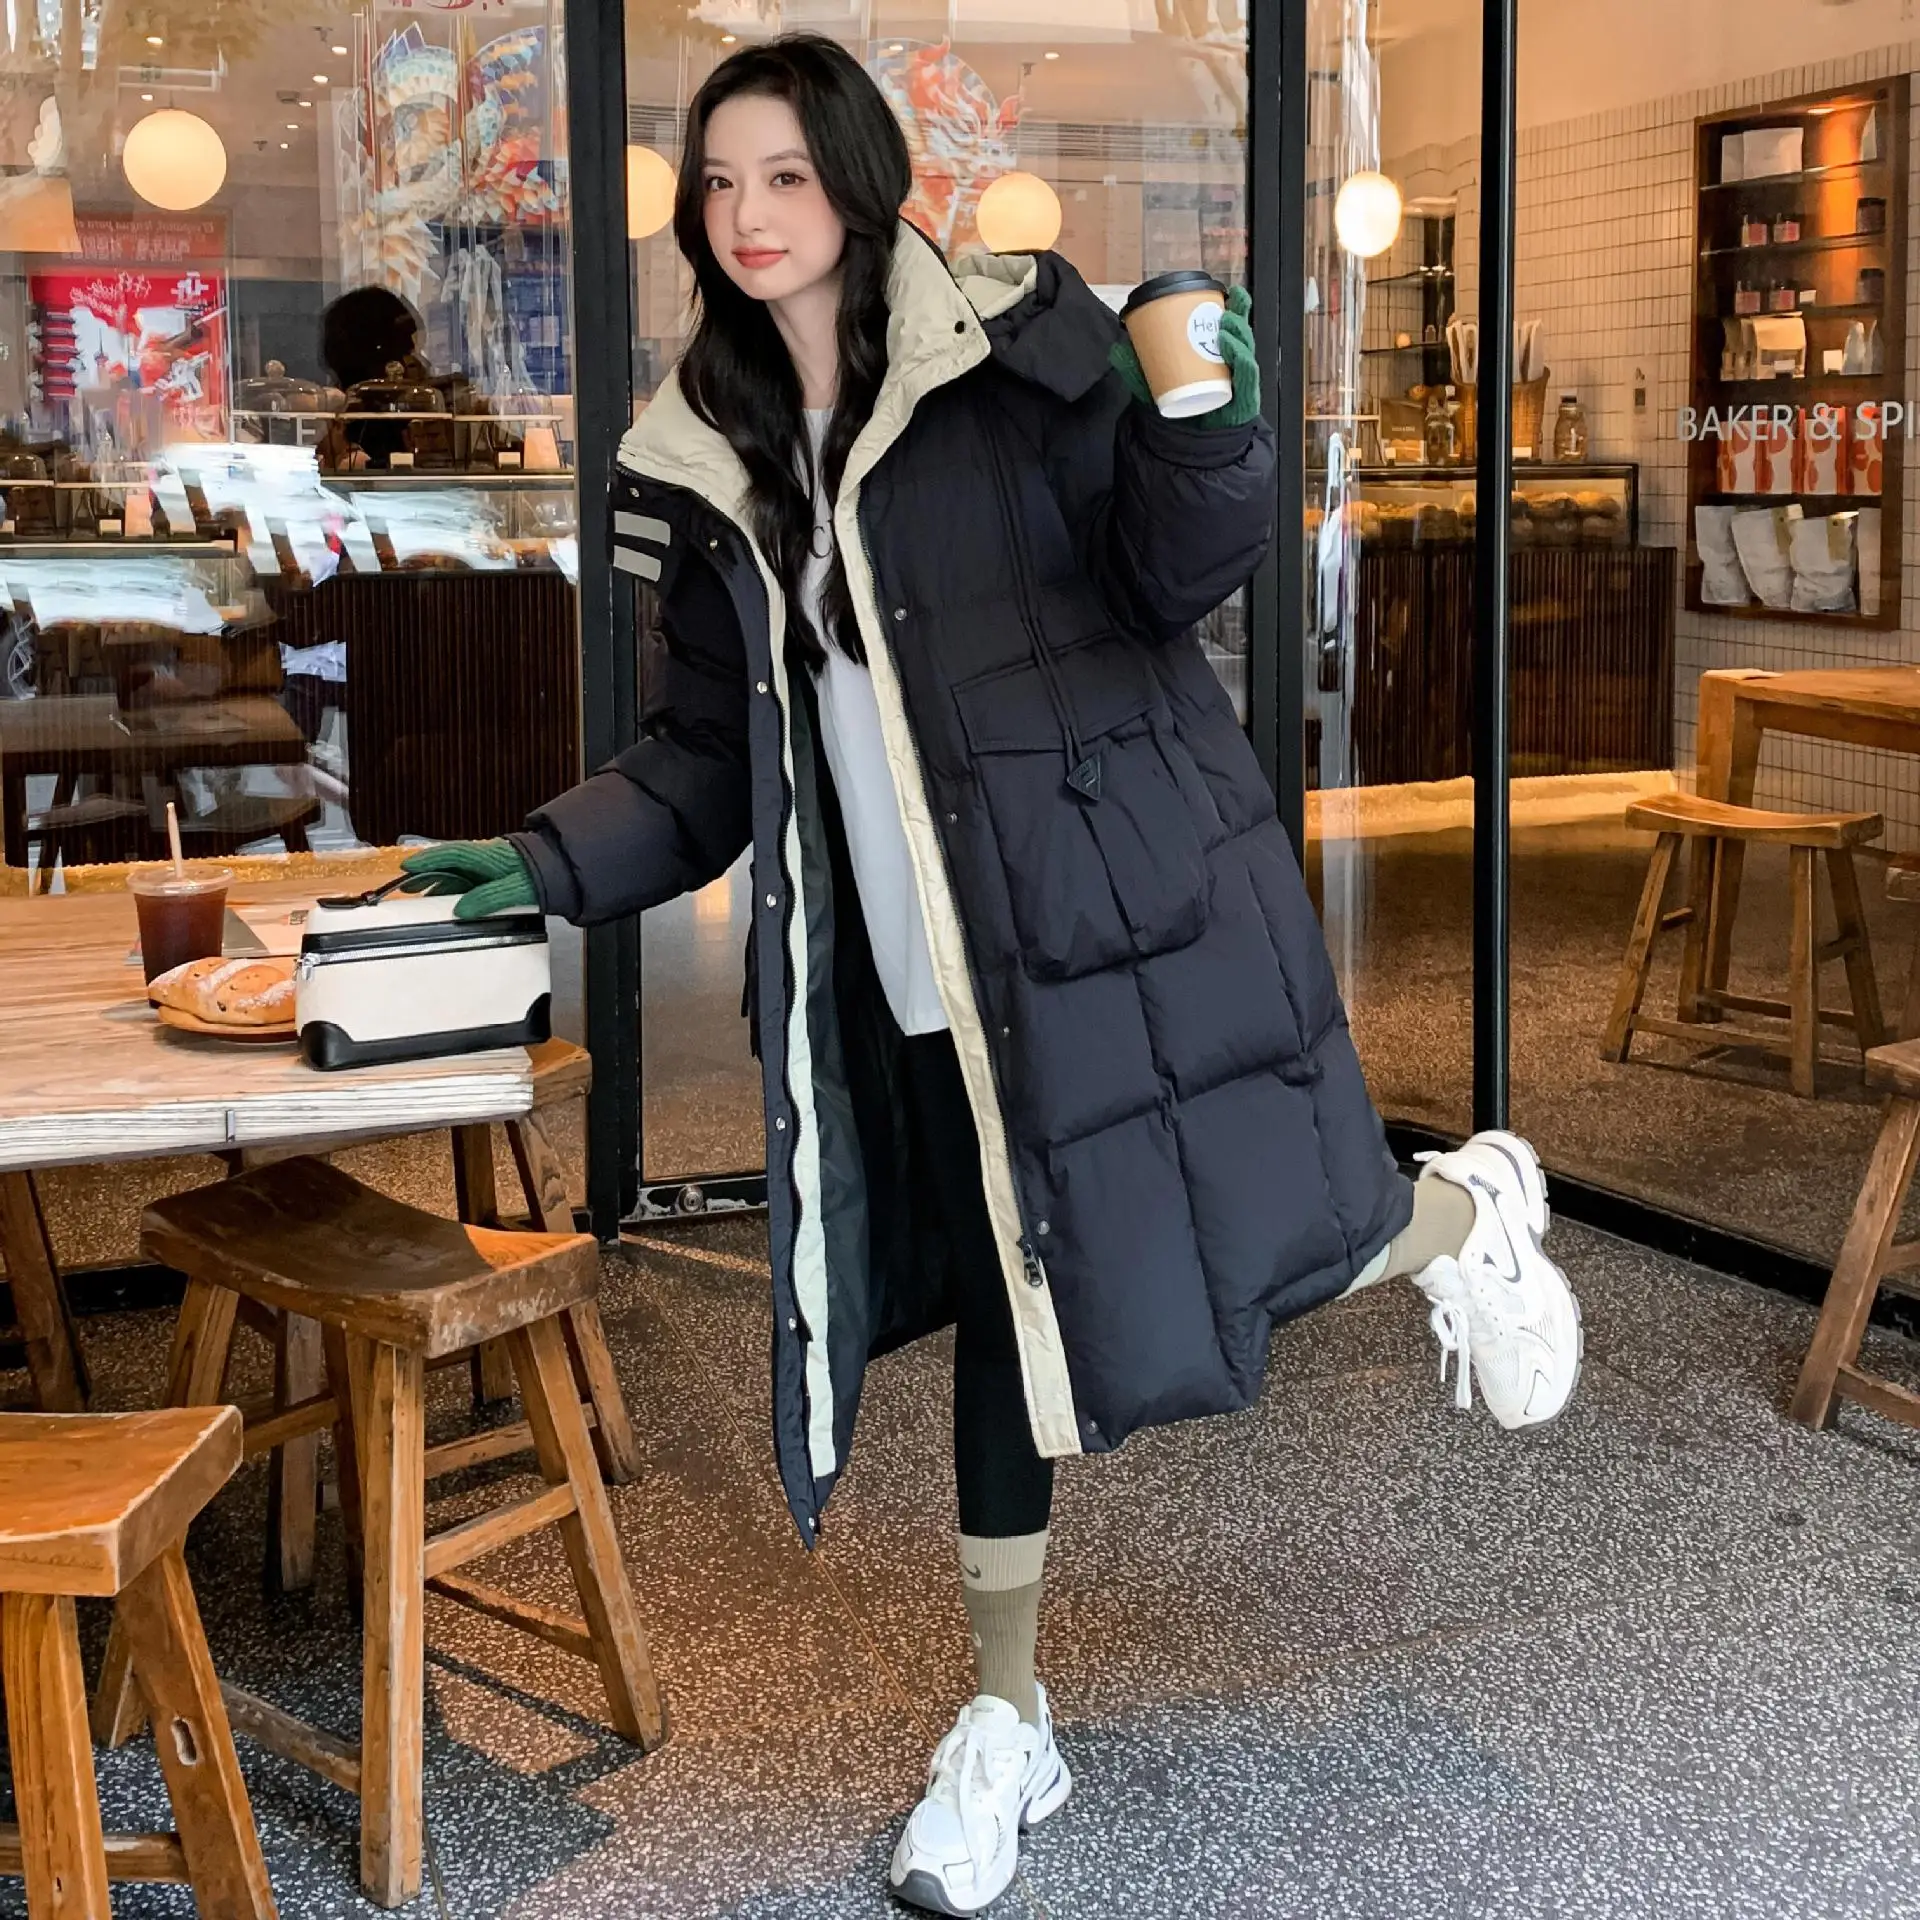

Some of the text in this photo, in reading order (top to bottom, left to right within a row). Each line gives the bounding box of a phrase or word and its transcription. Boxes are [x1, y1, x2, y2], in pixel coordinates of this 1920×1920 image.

[1675, 400, 1914, 442] BAKER & SPI
